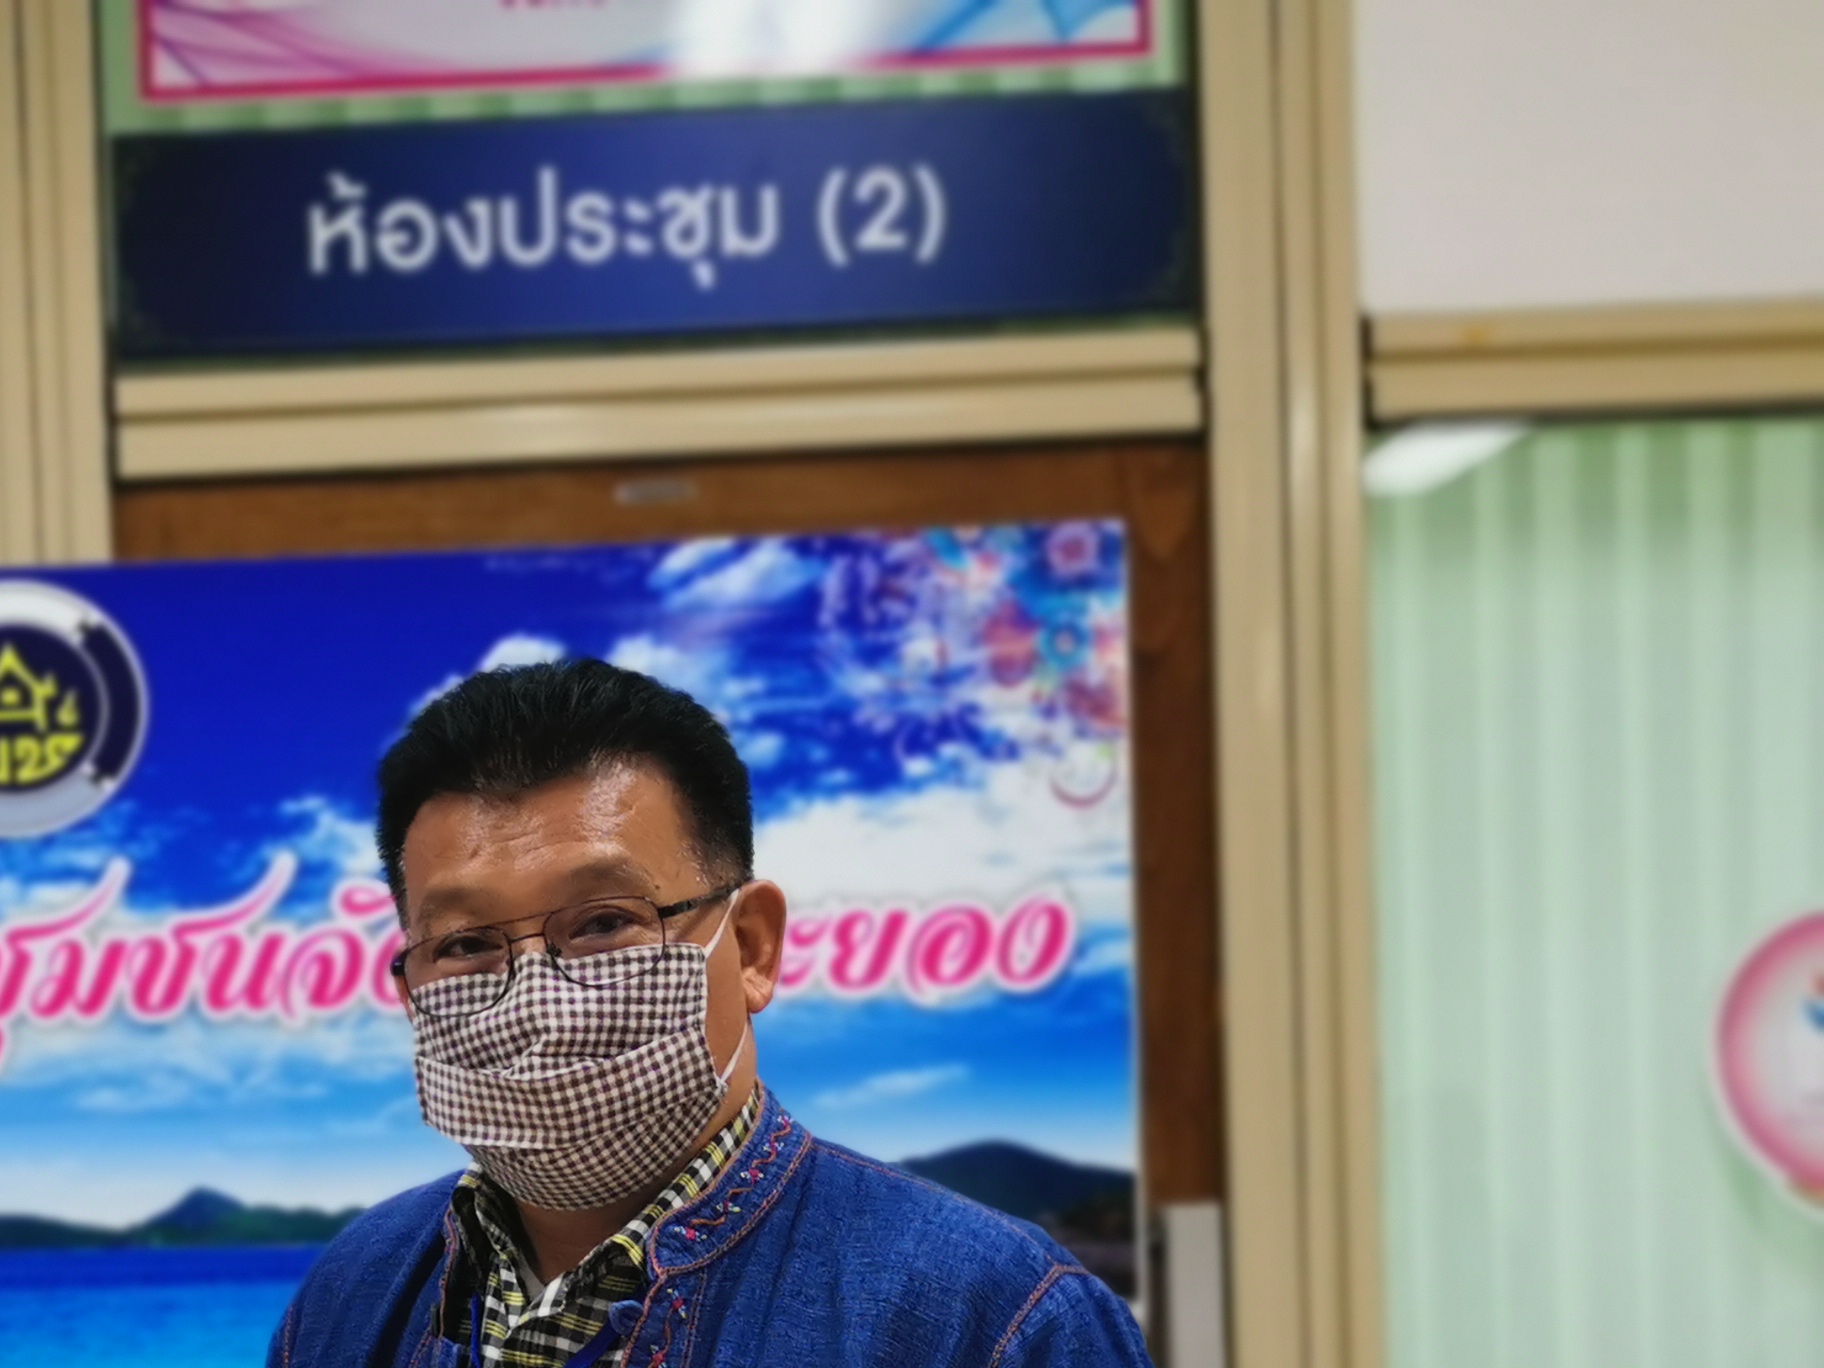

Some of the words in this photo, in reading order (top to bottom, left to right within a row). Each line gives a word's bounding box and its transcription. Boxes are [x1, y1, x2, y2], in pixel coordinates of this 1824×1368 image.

[307, 168, 778, 290] ห้องประชุม
[816, 163, 946, 268] (2)
